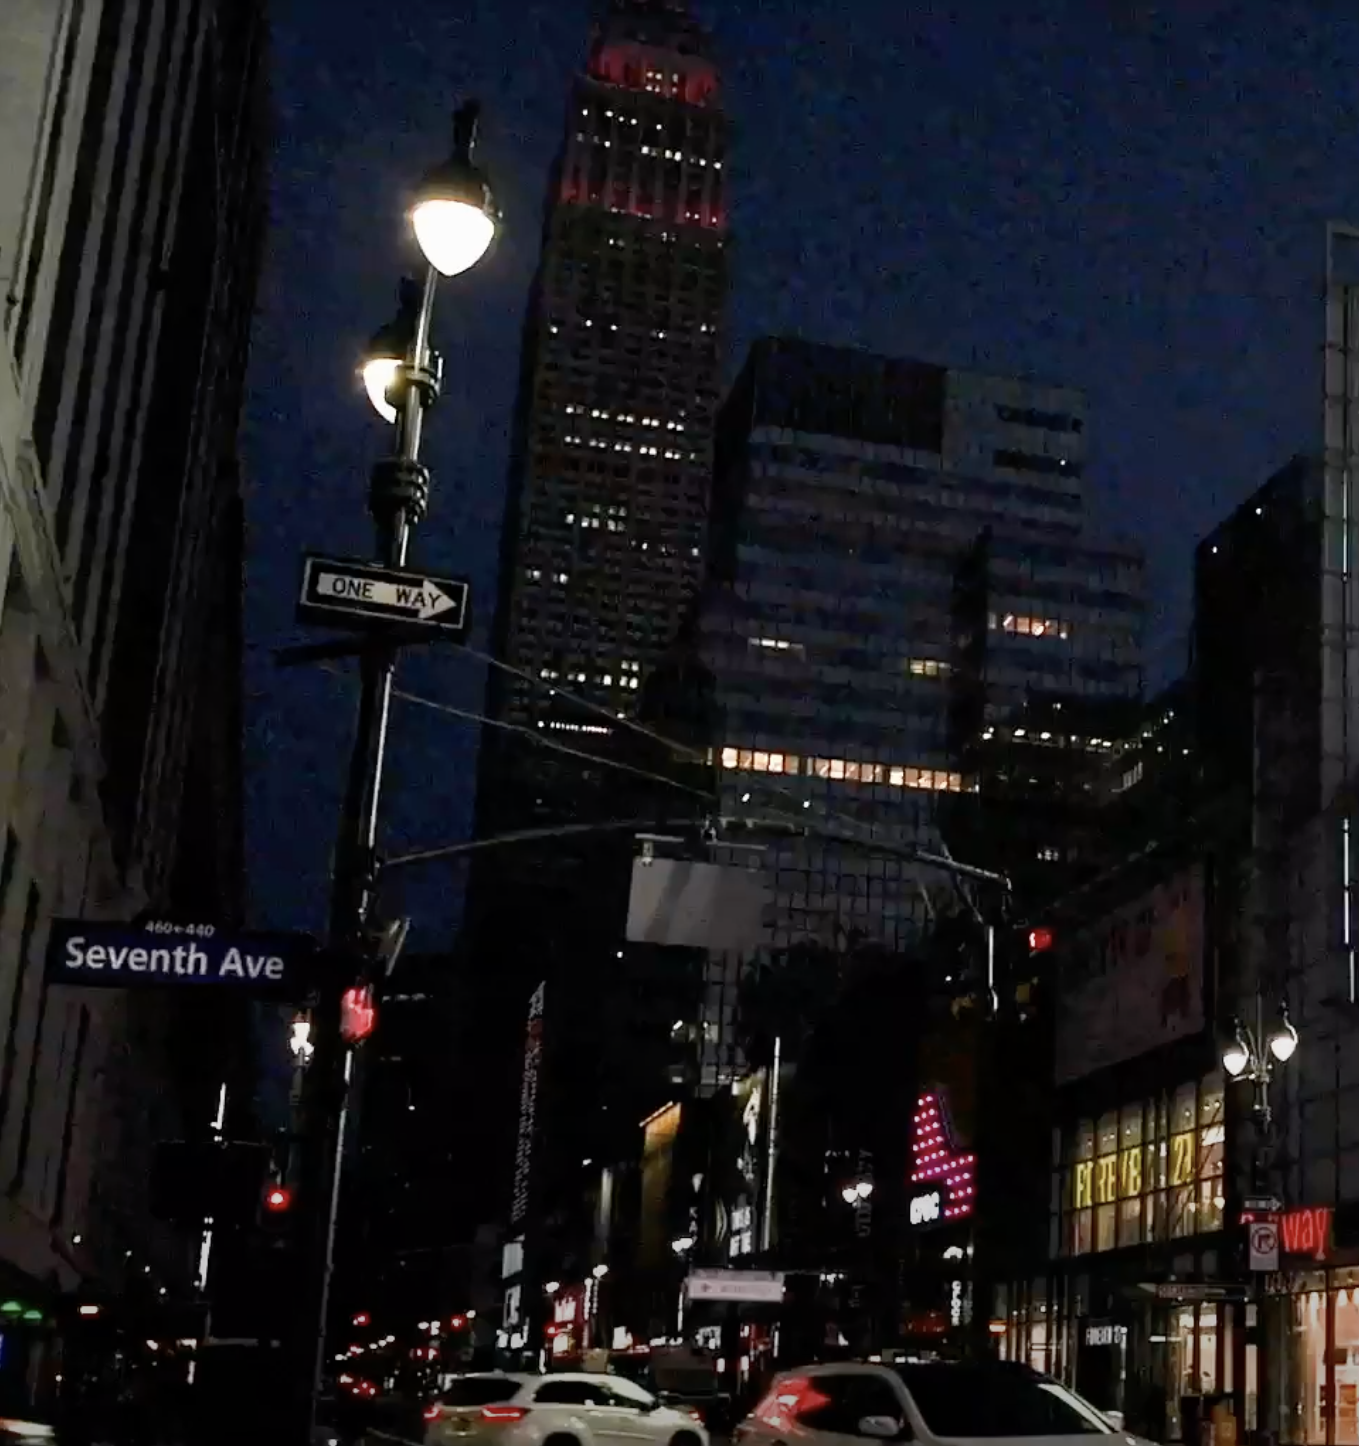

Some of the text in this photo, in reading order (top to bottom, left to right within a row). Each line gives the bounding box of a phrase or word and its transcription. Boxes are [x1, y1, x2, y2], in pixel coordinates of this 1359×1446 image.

[332, 577, 442, 611] ONE WAY
[145, 920, 216, 938] 460 440
[65, 936, 285, 980] Seventh Ave
